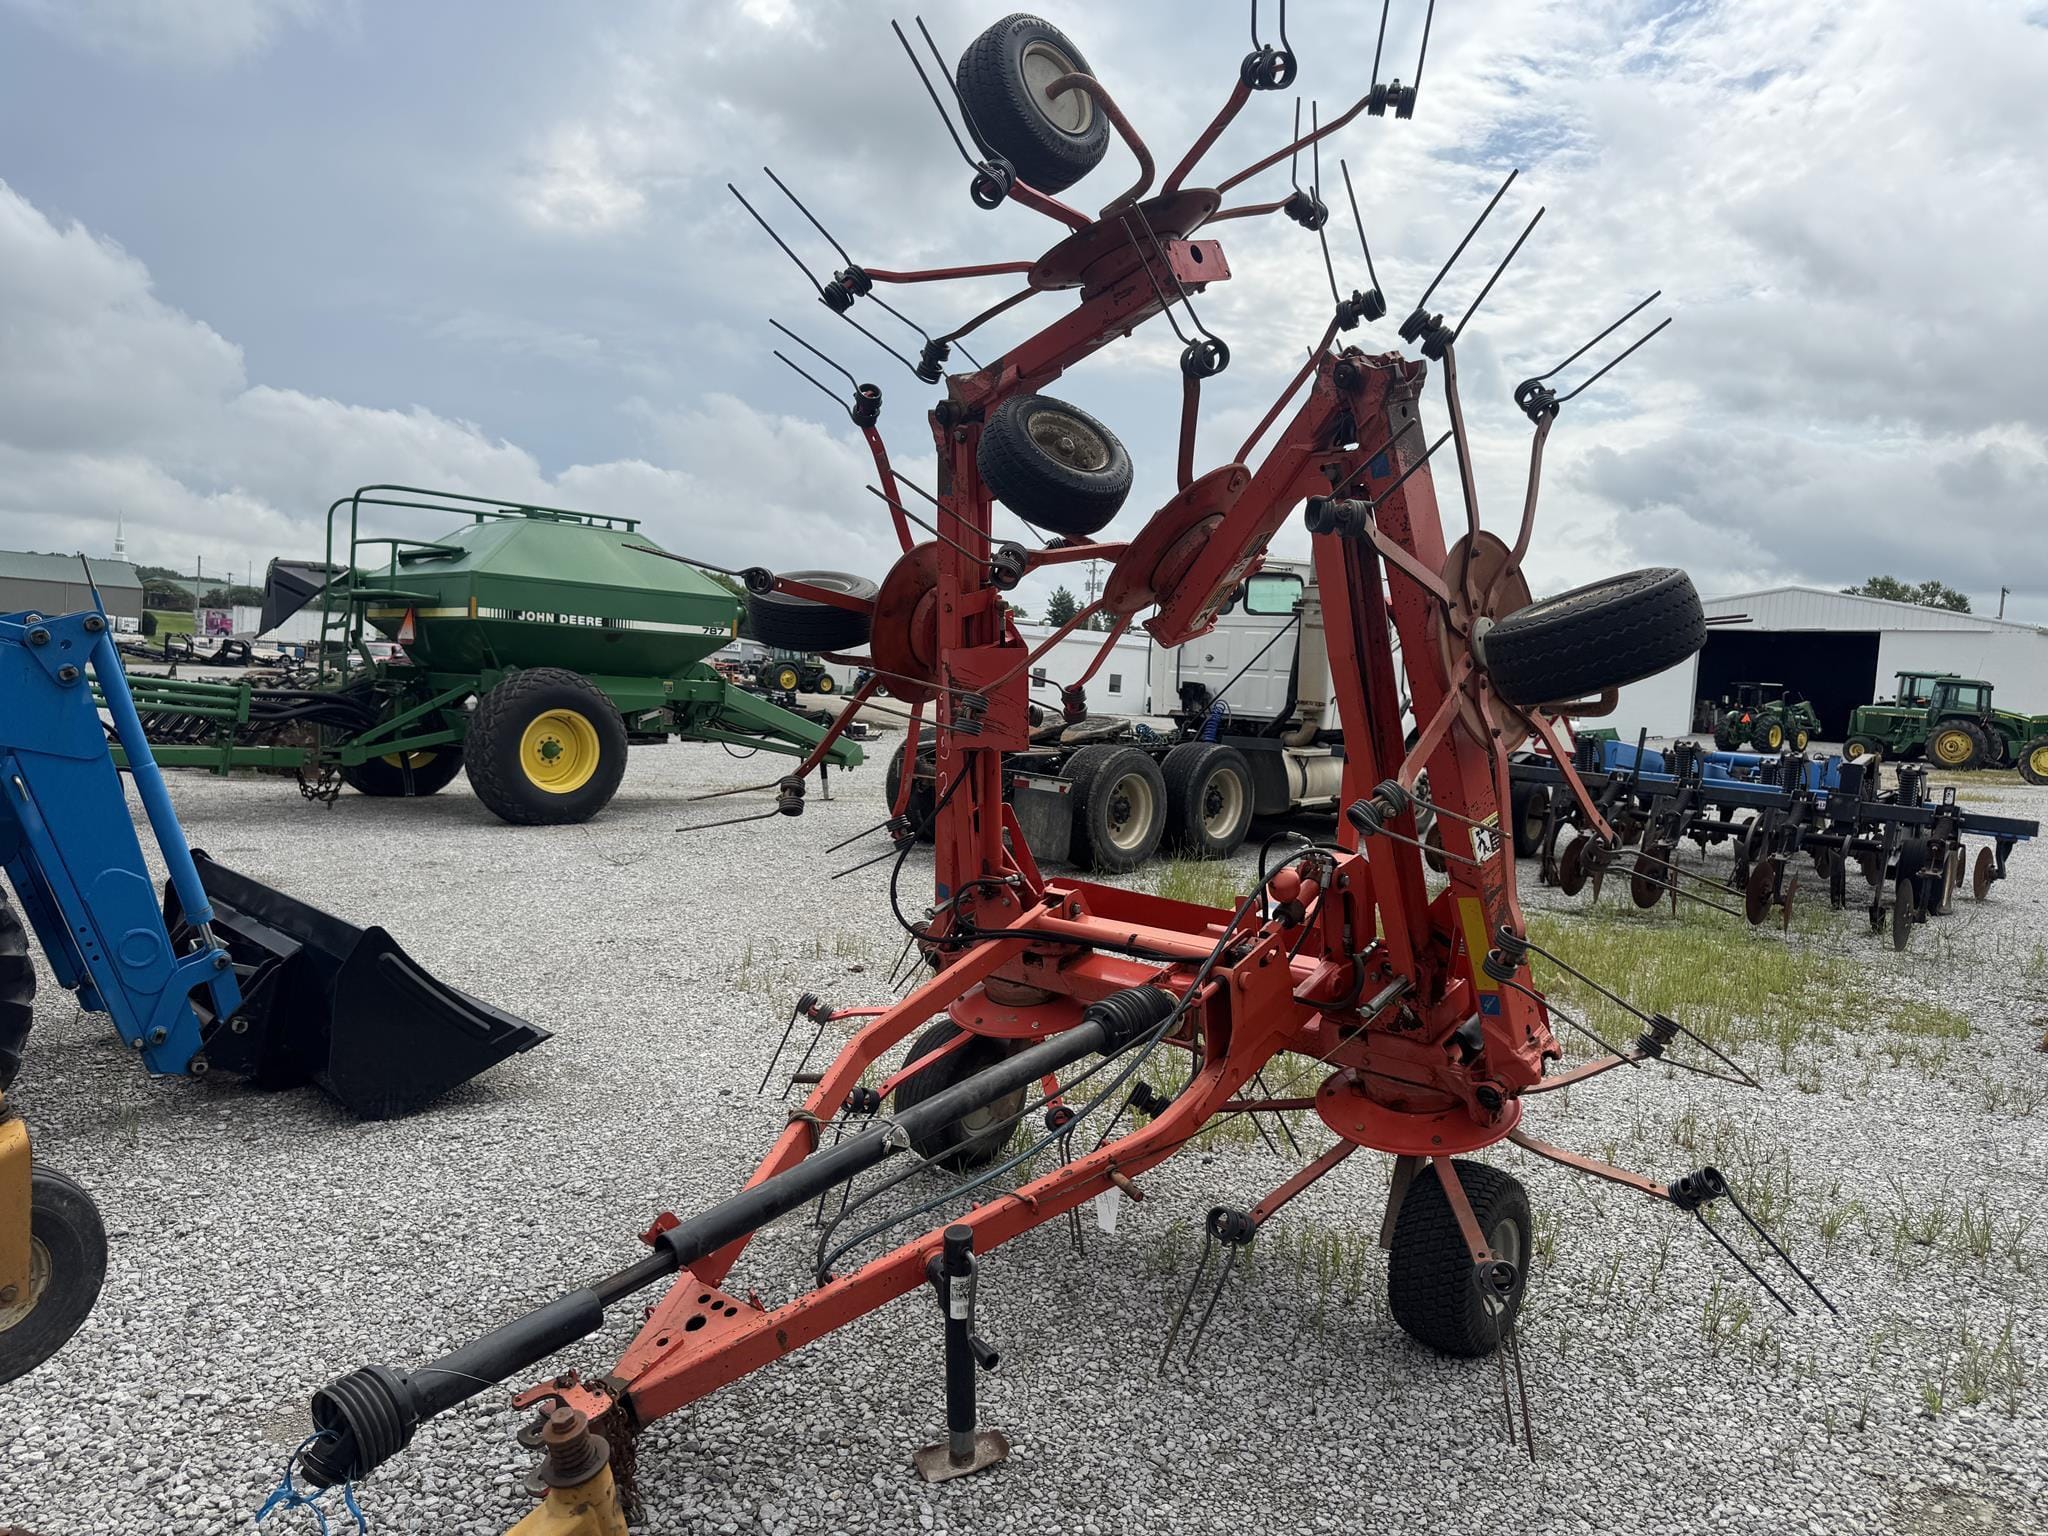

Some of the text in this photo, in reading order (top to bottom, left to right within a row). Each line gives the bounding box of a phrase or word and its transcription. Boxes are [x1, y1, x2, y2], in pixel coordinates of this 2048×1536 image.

[518, 611, 603, 627] JOHN DEERE
[702, 626, 725, 636] 787
